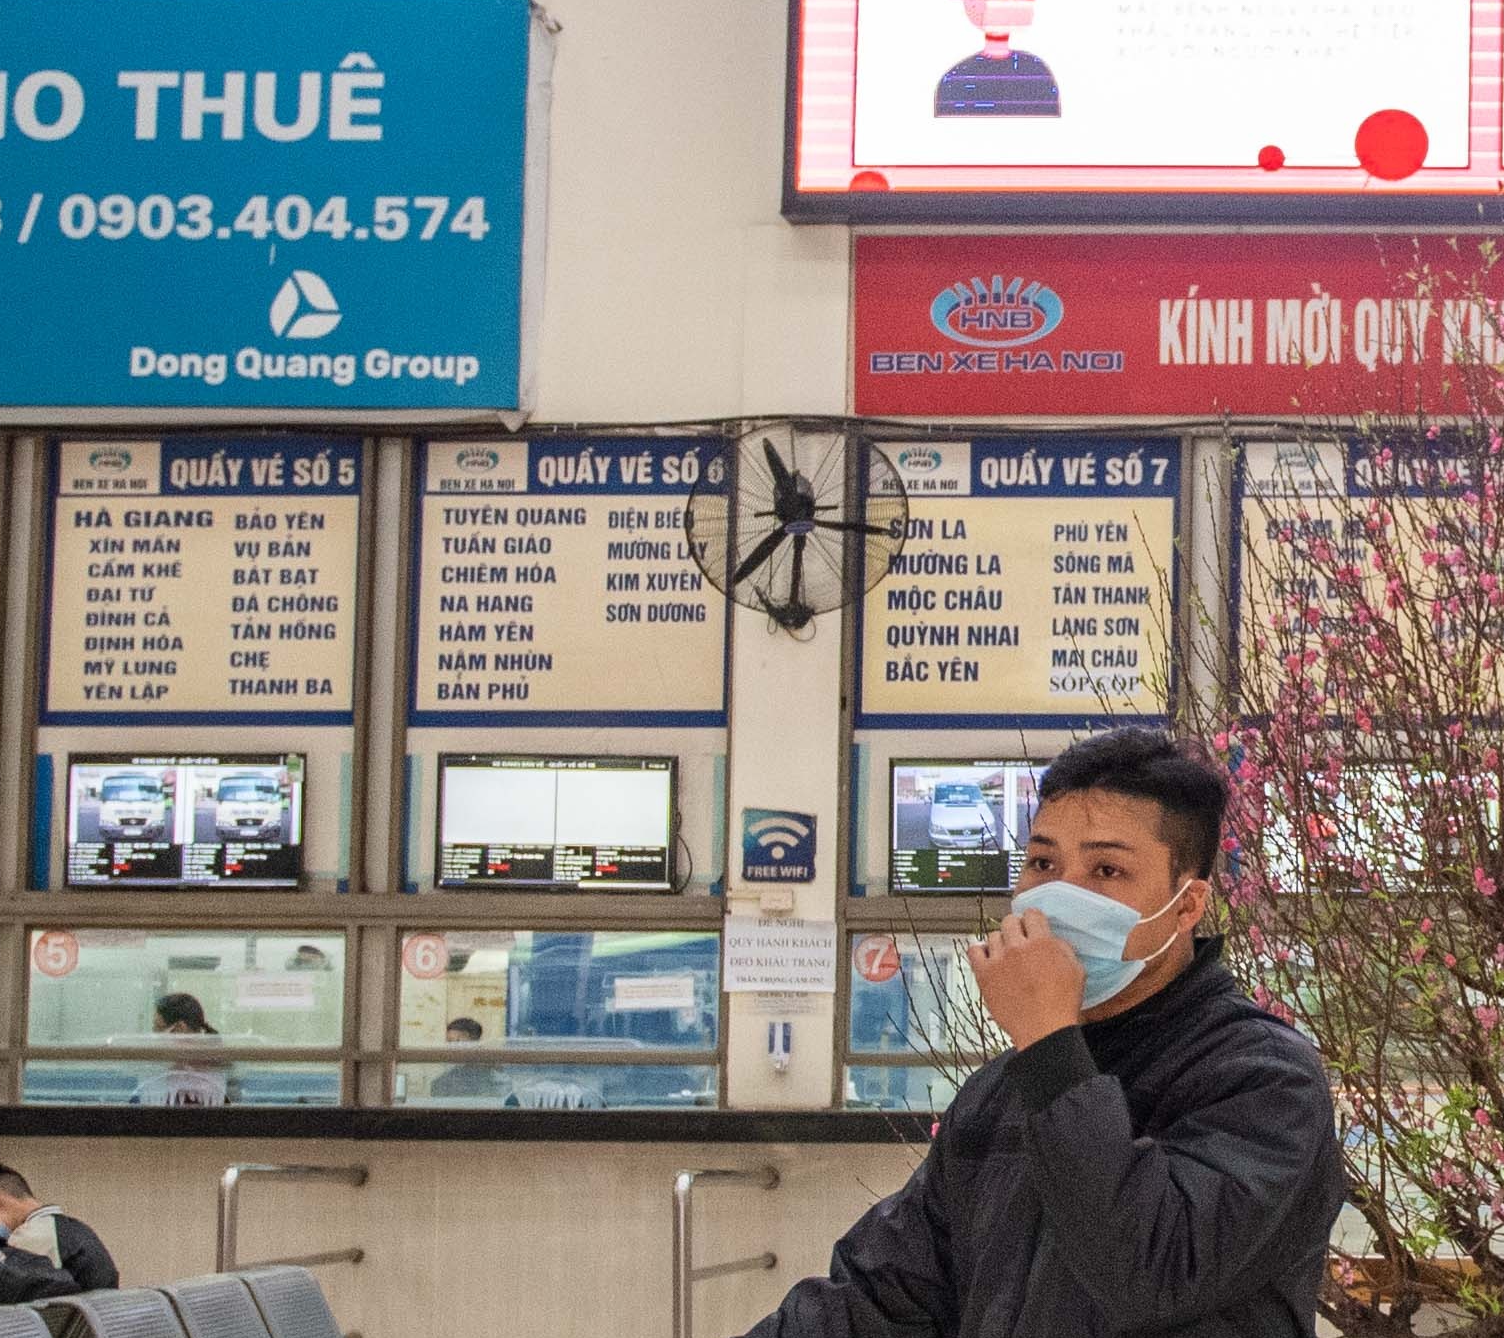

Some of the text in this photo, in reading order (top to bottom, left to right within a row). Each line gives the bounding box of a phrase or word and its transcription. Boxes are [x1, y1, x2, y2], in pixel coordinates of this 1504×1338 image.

[118, 54, 385, 143] THUÊ
[58, 195, 490, 243] 0903.404.574
[958, 308, 1033, 330] HNB
[1159, 285, 1253, 366] KÍNH
[1266, 281, 1343, 367] MỜI
[130, 346, 480, 386] Dong Quang Group
[949, 351, 1000, 374] XE
[1004, 351, 1055, 374] HA
[980, 446, 1169, 488] QUẦY VÉ SỐ 7
[123, 510, 214, 529] GIANG
[515, 507, 587, 527] QUANG
[941, 520, 967, 541] LA
[1095, 518, 1128, 542] YÊN
[976, 555, 1001, 576] LA
[1053, 552, 1101, 575] SÔNG
[440, 595, 534, 613] NA HANG
[887, 584, 1003, 618] MỘC CHÂU
[1093, 585, 1150, 606] THANH
[967, 626, 1020, 648] NHAI
[1103, 616, 1140, 637] SƠN
[885, 652, 979, 683] BẮC YÊN
[1052, 645, 1138, 670] MAI CHÂU
[229, 678, 333, 696] THANH BA
[747, 865, 809, 878] FREE WIFI
[45, 937, 68, 965] 5
[414, 939, 436, 969] 6
[865, 942, 889, 972] 7
